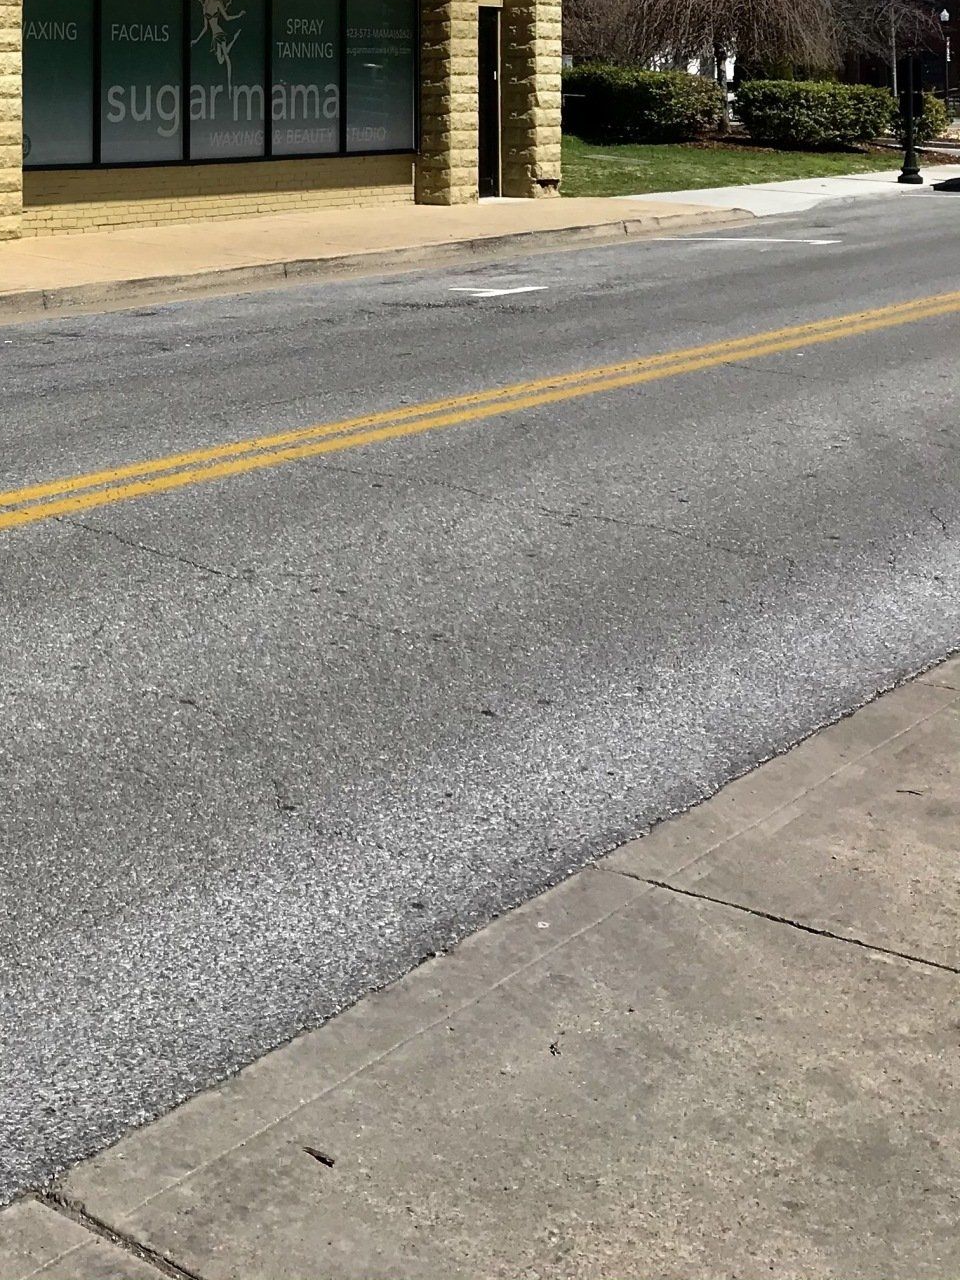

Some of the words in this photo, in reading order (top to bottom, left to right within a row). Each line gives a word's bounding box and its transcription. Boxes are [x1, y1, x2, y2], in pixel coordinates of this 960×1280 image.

[22, 21, 78, 41] AXING
[111, 24, 170, 42] FACIALS
[286, 18, 325, 36] SPRAY
[276, 41, 334, 59] TANNING
[106, 84, 224, 138] sugar
[233, 83, 340, 121] mama
[209, 130, 264, 147] WAXING
[272, 130, 283, 145] &
[286, 128, 334, 145] BEAUTY
